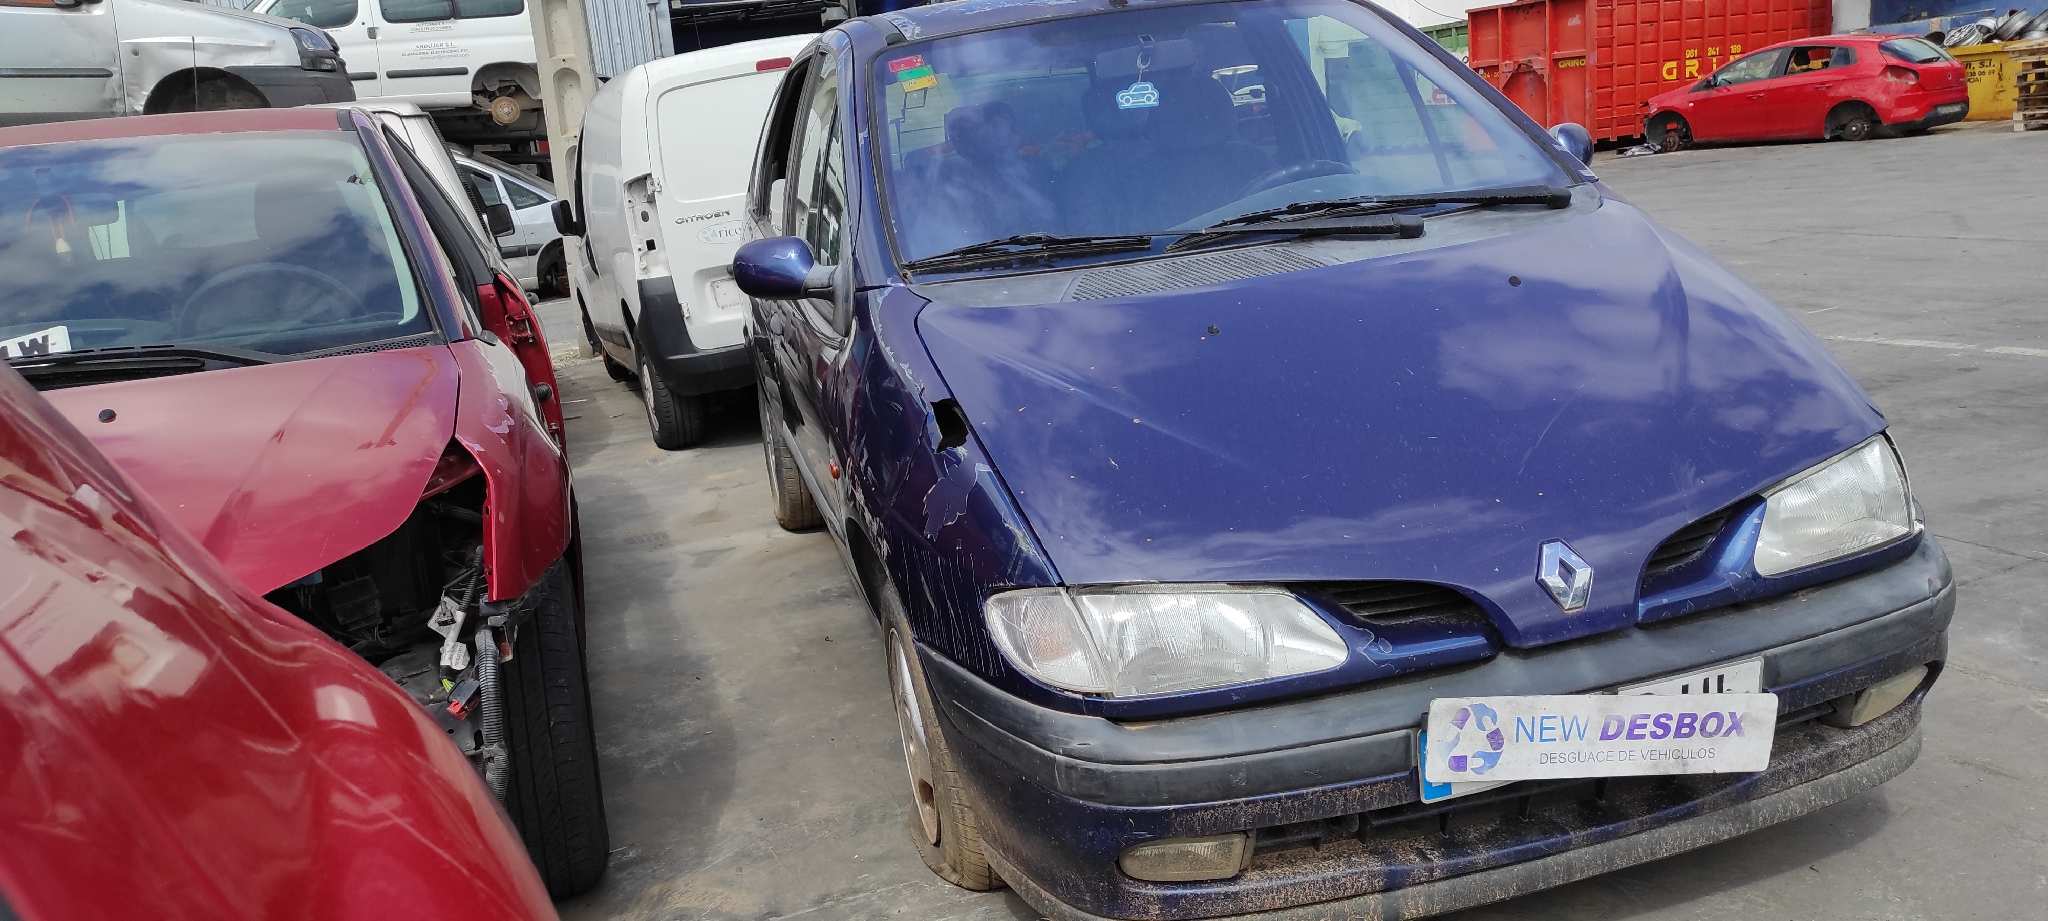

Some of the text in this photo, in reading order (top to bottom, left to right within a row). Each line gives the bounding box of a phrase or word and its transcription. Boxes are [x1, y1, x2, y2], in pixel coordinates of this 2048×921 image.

[1515, 711, 1745, 743] NEW DESBOX
[1539, 747, 1716, 765] DESGUACE DE VEHICULOS
